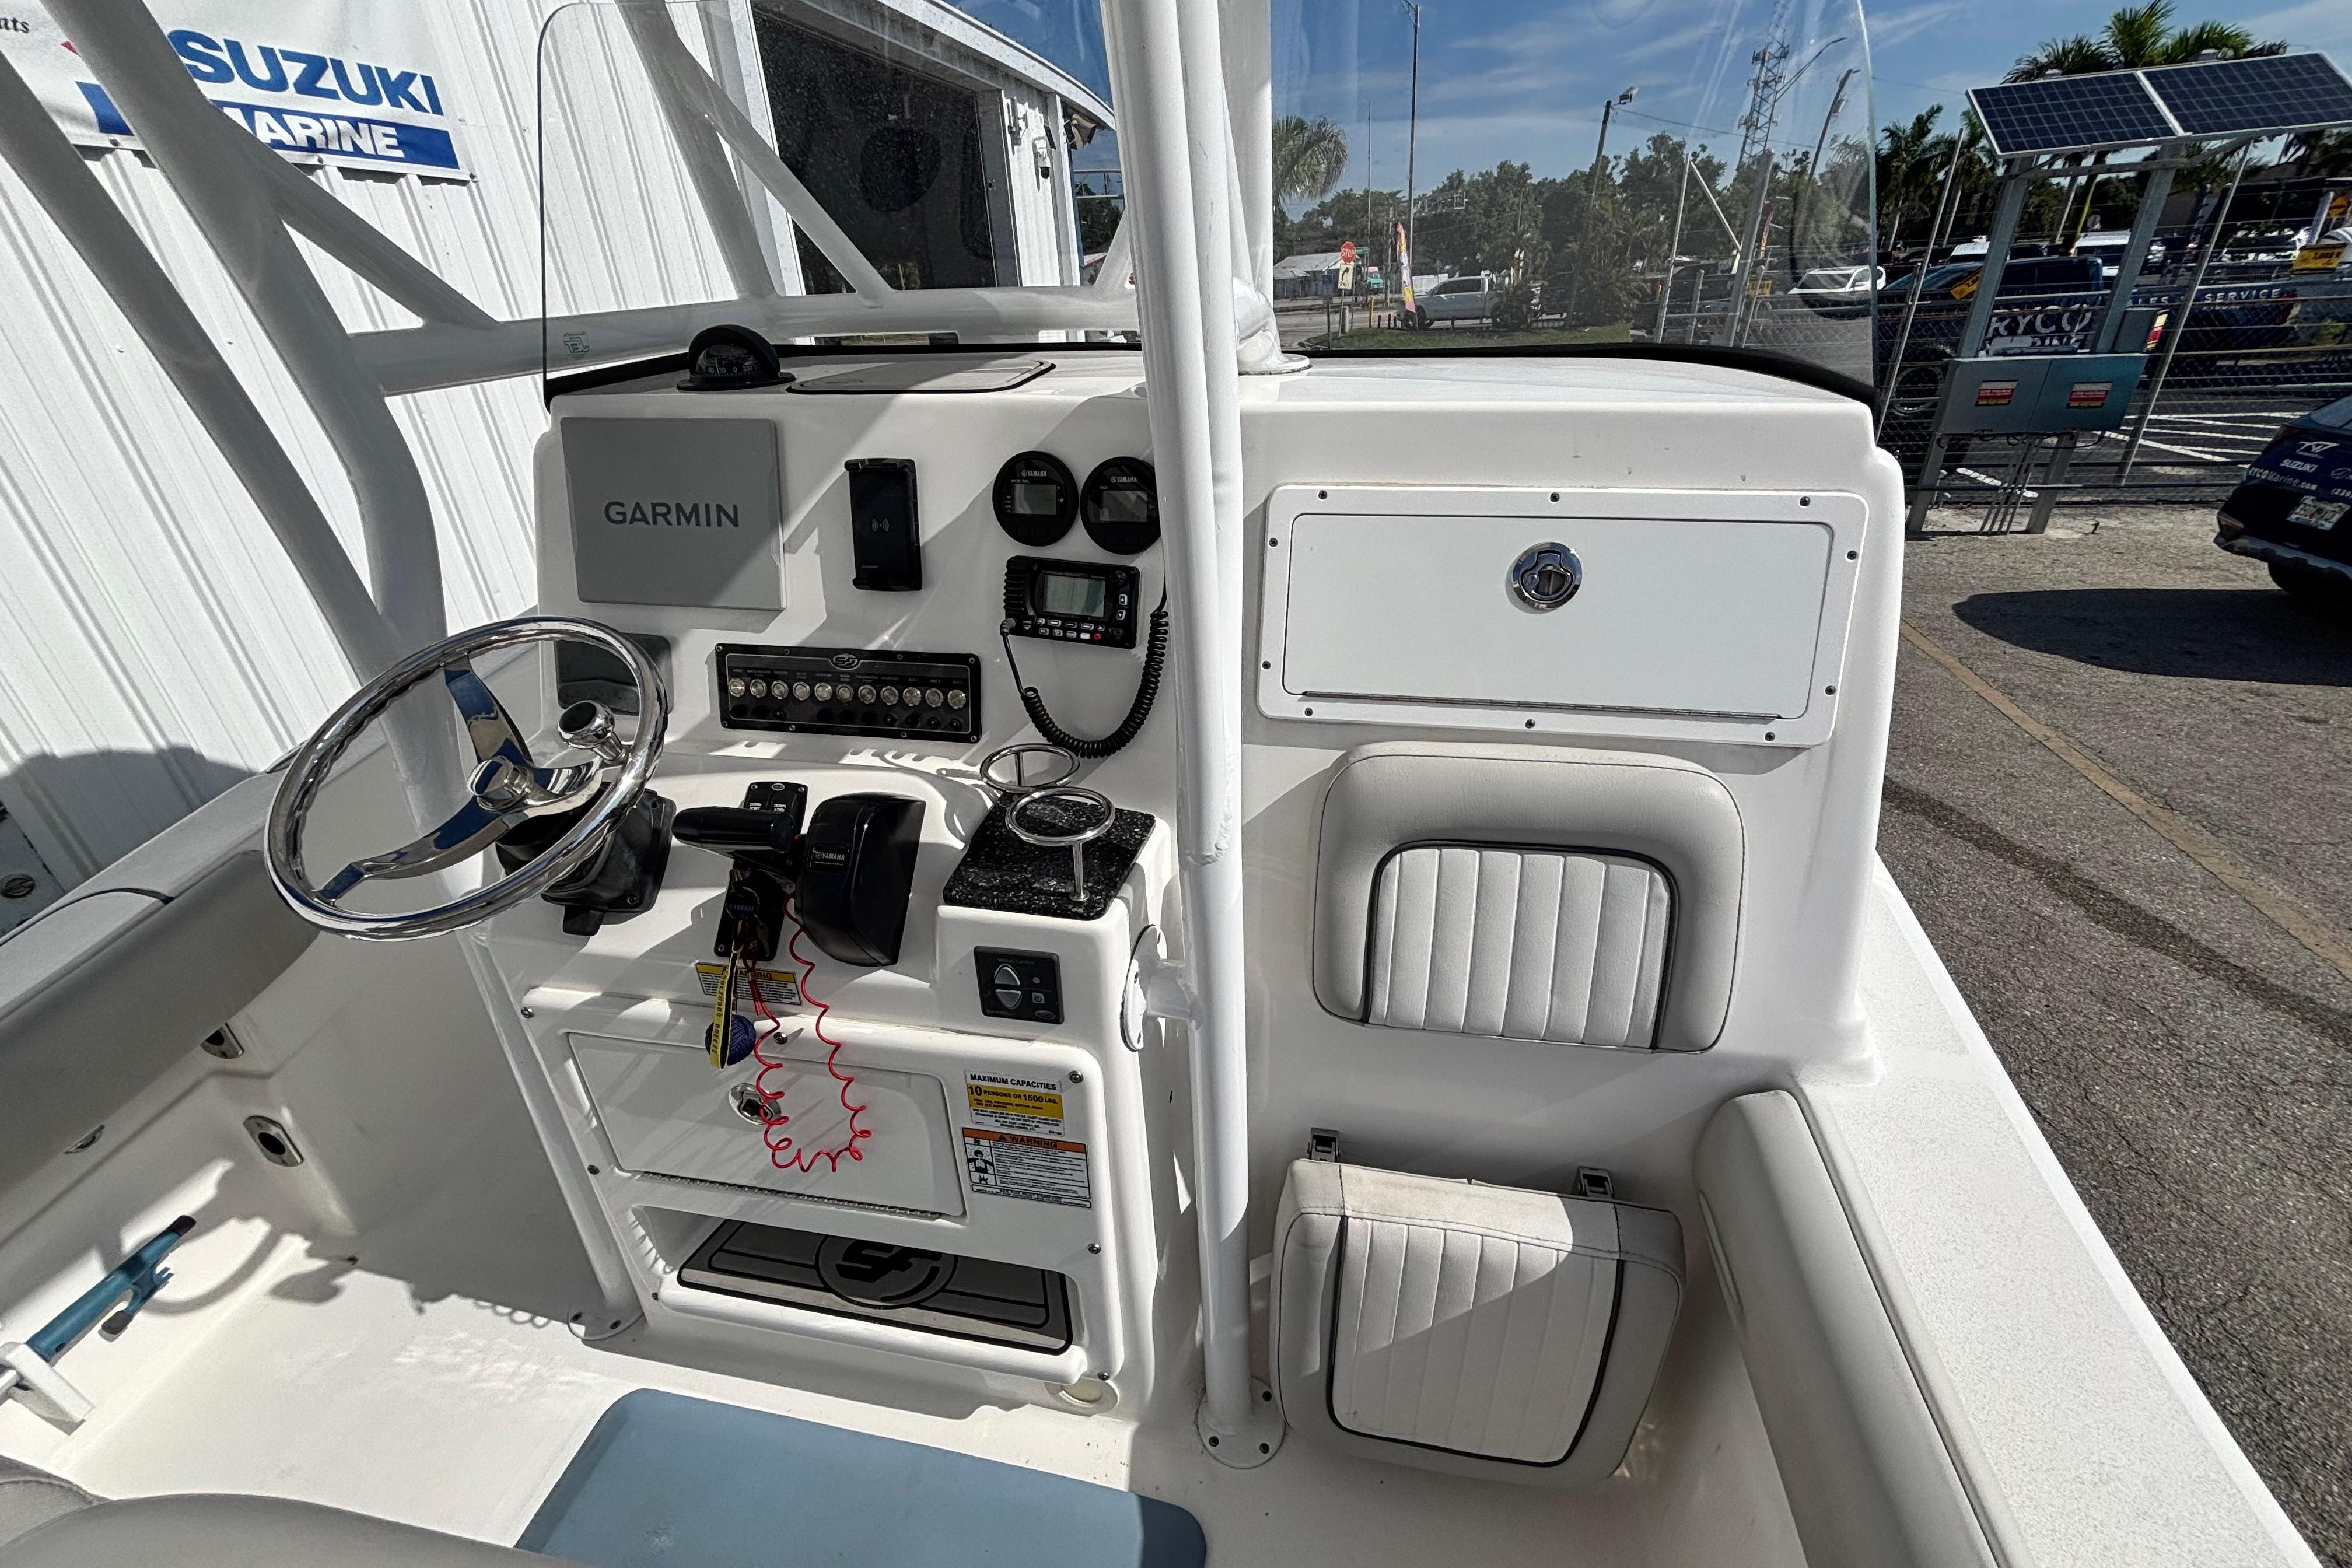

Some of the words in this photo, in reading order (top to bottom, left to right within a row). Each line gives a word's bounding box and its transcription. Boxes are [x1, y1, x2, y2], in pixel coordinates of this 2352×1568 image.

[167, 29, 444, 116] SUZUKI
[1342, 249, 1354, 257] STOP
[2203, 289, 2281, 303] SERVICE
[1984, 304, 2092, 337] RYCO
[2280, 459, 2319, 473] SUZUKI
[604, 501, 740, 528] GARMIN
[822, 852, 845, 861] YAMAHA
[970, 1074, 1009, 1084] MAXIMUM
[1010, 1079, 1056, 1090] CAPACITIES
[969, 1085, 982, 1096] 10
[984, 1090, 1012, 1098] PERSONS
[1023, 1094, 1044, 1102] 1500
[1009, 1135, 1058, 1149] WARNING
